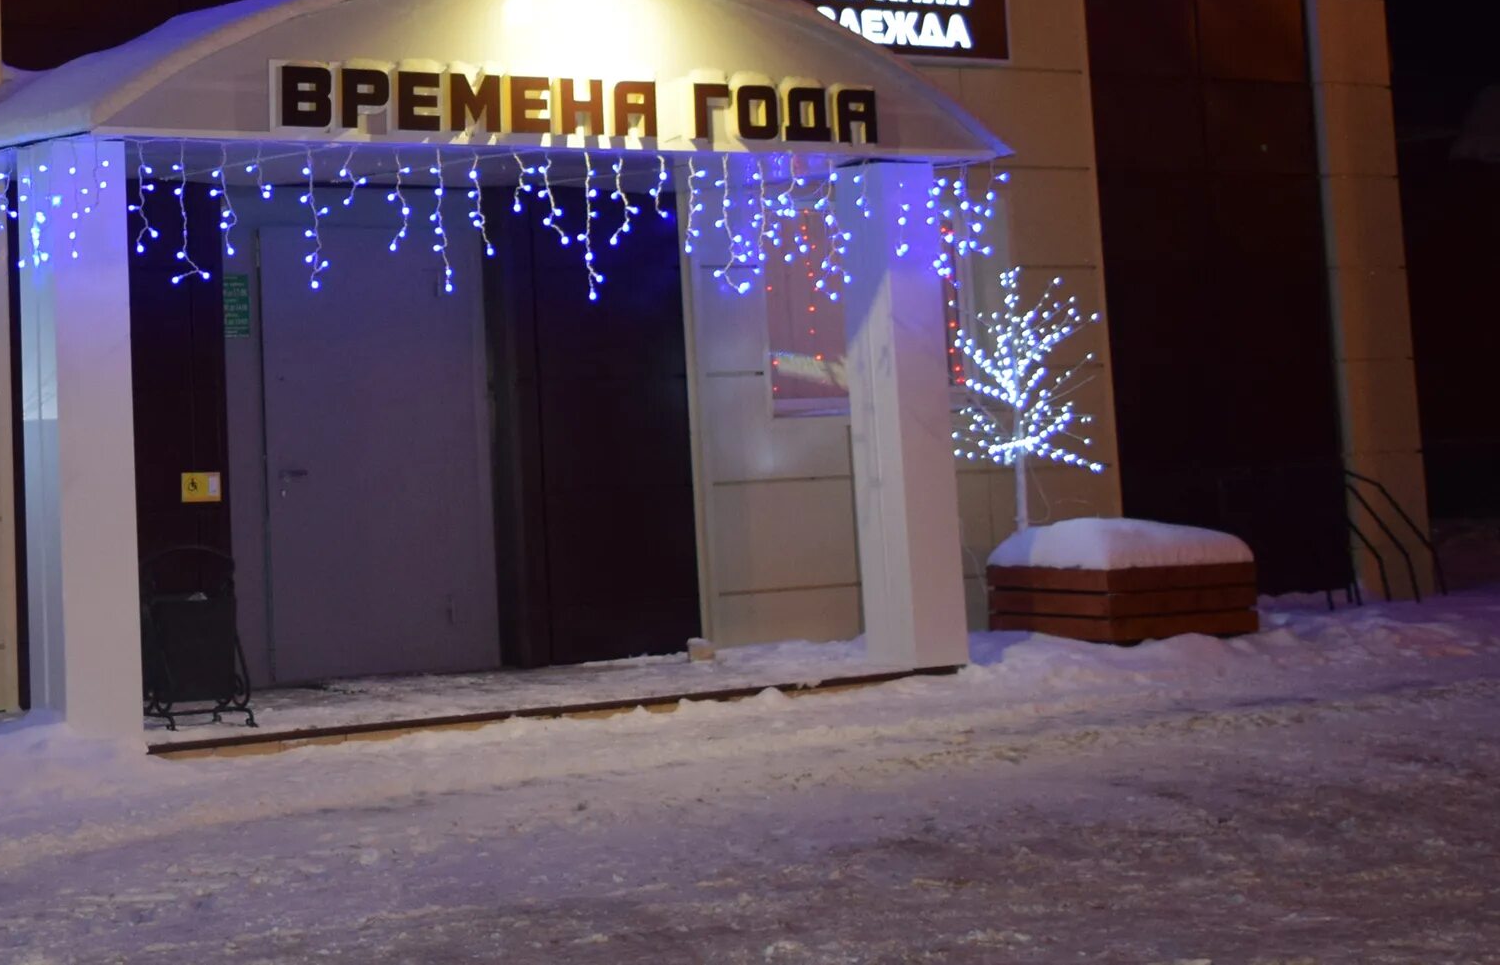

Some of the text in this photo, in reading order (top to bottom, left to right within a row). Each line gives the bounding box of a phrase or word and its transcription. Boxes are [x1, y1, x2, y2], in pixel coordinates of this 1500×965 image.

[816, 6, 972, 49] ЕЖДА
[281, 65, 878, 144] ВРЕМЕНА ГОДА
